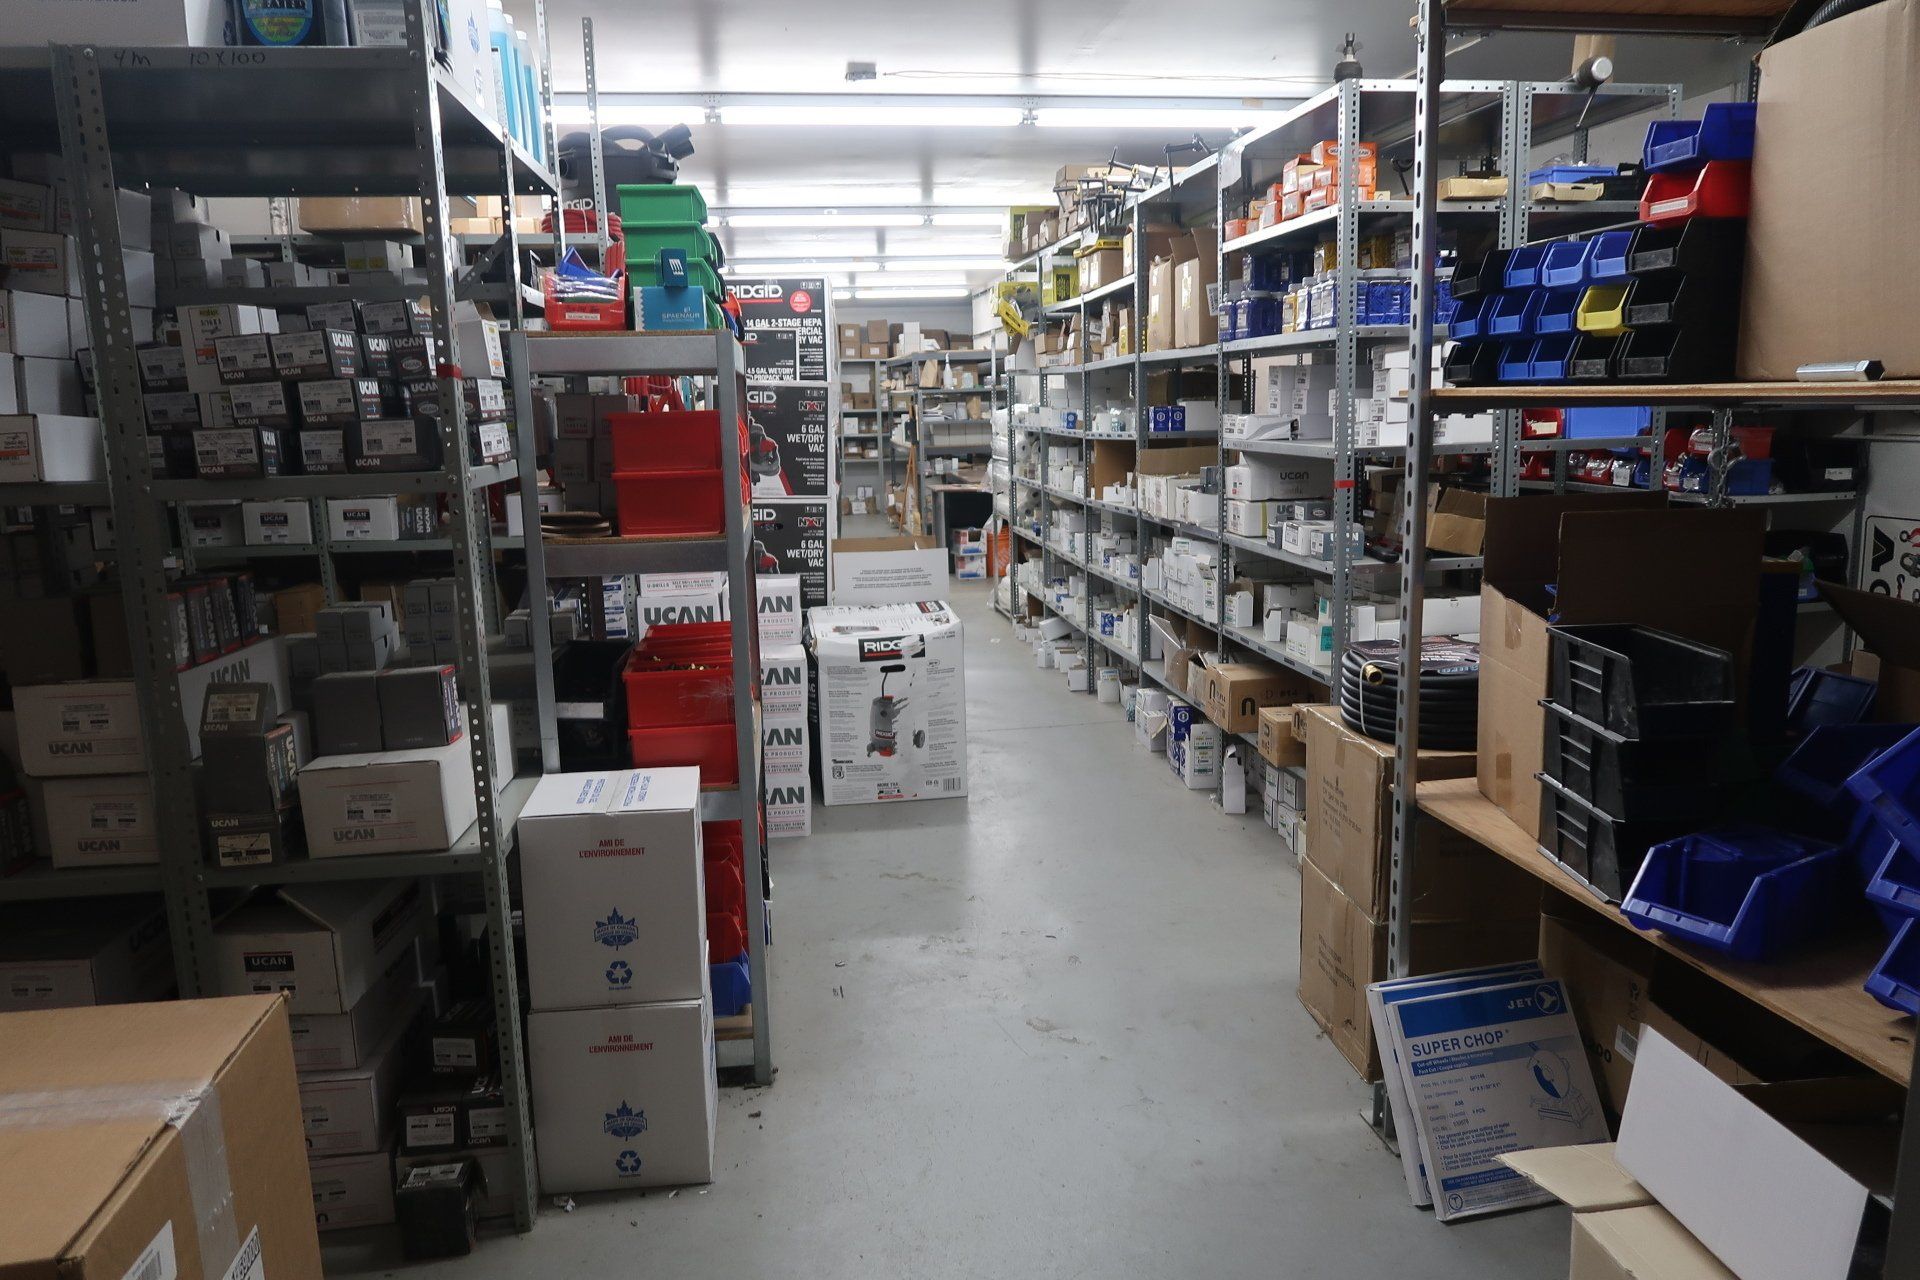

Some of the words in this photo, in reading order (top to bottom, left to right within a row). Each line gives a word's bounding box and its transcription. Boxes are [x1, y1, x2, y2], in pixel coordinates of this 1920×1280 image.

[746, 319, 754, 328] 14
[755, 319, 770, 328] GAL
[771, 318, 801, 328] 2-STAGE
[803, 317, 822, 327] HEPA
[798, 326, 822, 336] ERCIAL
[331, 333, 354, 349] UCAN
[394, 336, 424, 349] UCAN
[808, 335, 823, 344] VAC
[223, 371, 246, 380] UCAN
[280, 368, 302, 376] UCAN
[359, 380, 380, 395] UCAN
[747, 391, 777, 404] GID
[237, 417, 260, 427] UCAN
[306, 415, 328, 424] UCAN
[801, 424, 807, 434] 6
[808, 424, 825, 434] GAL
[787, 433, 825, 444] WET/DRY
[808, 443, 825, 453] VAC
[306, 463, 328, 472] UCAN
[355, 457, 381, 467] UCAN
[200, 466, 225, 474] UCAN
[1277, 504, 1295, 515] UC
[263, 515, 285, 523] UCAN
[801, 539, 806, 549] 6
[808, 539, 824, 549] GAL
[786, 549, 824, 559] WET/DRY
[808, 558, 824, 567] VAC
[758, 595, 793, 613] AN
[643, 605, 714, 625] UCAN
[863, 641, 901, 653] RIDG
[203, 723, 228, 732] UCAN
[764, 728, 803, 746] AN
[48, 741, 93, 754] UCAN
[766, 786, 805, 806] AN
[211, 818, 239, 828] UCAN
[333, 828, 375, 842] UCAN
[77, 840, 120, 852] UCAN
[599, 839, 613, 848] AMI
[614, 838, 625, 846] DE
[579, 847, 646, 859] L'ENVIRONNEMENT
[251, 956, 287, 967] UCAN
[1507, 998, 1535, 1010] JET
[608, 1035, 622, 1043] AMI
[623, 1034, 634, 1042] DE
[1411, 1037, 1461, 1057] SUPER
[1464, 1030, 1504, 1048] CHOP
[589, 1042, 654, 1054] L'ENVIRONNEMENT
